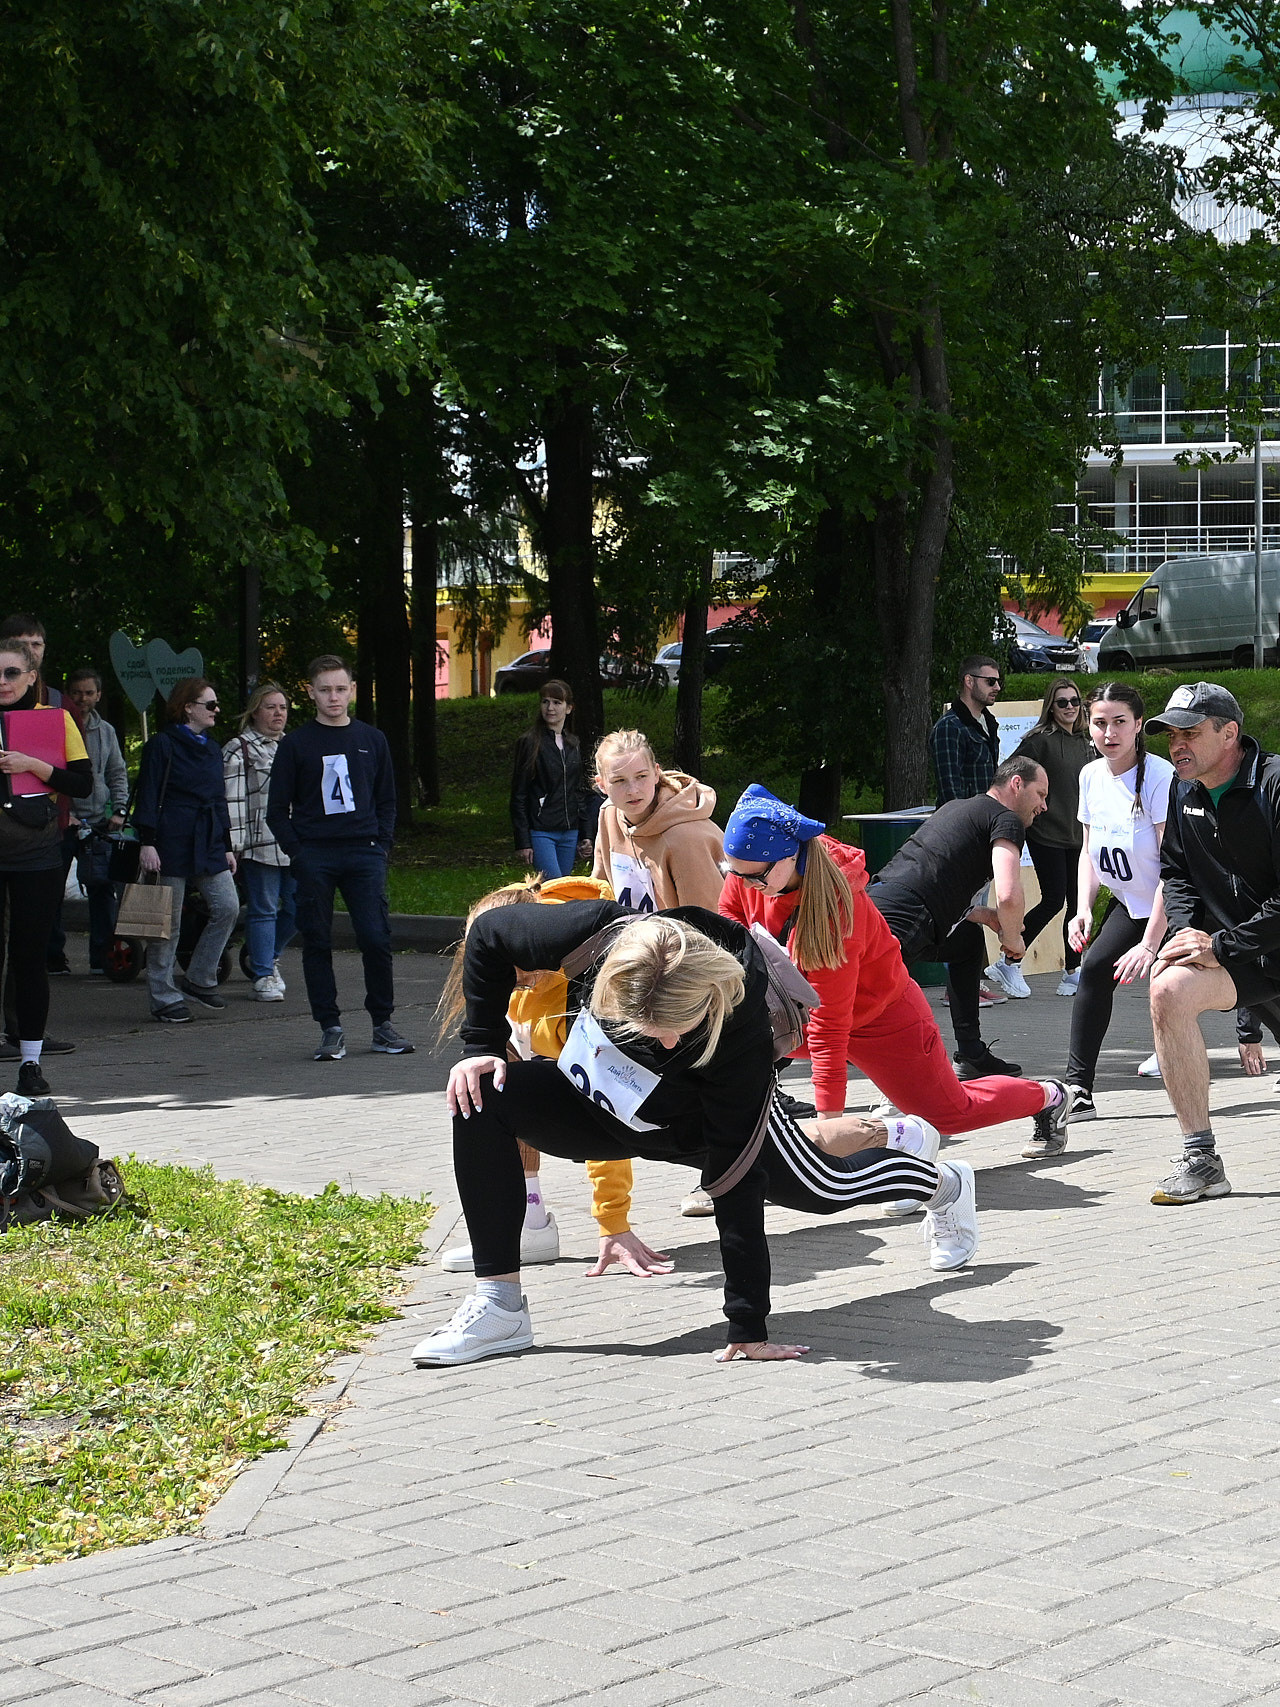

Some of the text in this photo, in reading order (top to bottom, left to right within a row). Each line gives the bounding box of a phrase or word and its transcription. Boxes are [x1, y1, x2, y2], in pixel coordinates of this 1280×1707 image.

[127, 659, 145, 669] сдай
[156, 666, 196, 675] поделись
[1100, 846, 1133, 881] 40
[607, 1065, 621, 1077] Дай
